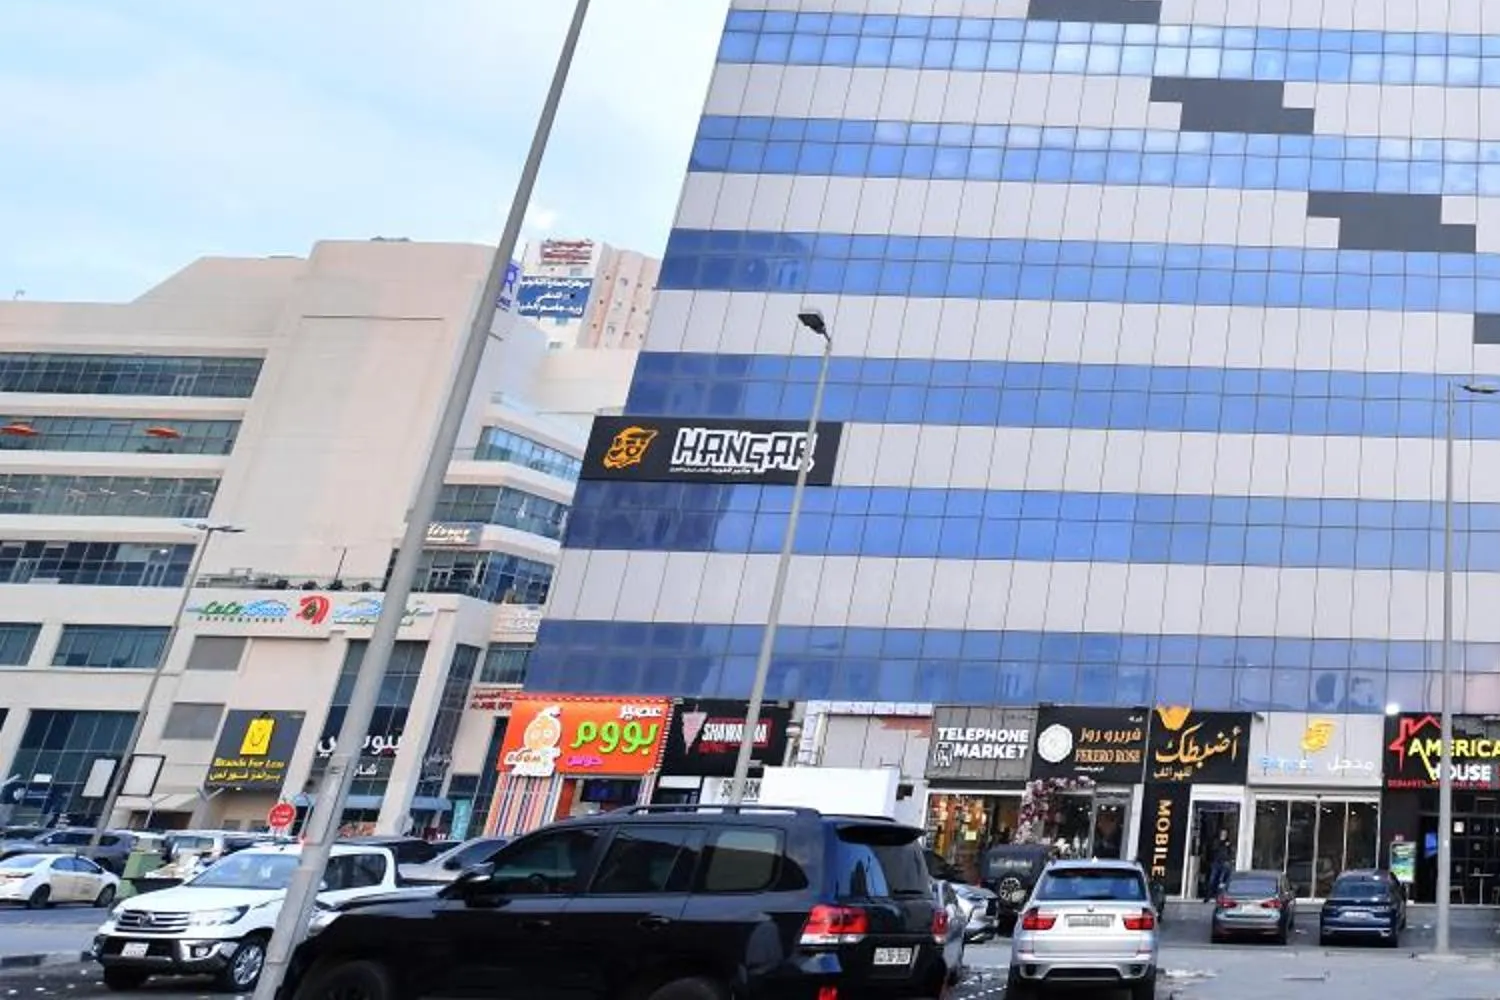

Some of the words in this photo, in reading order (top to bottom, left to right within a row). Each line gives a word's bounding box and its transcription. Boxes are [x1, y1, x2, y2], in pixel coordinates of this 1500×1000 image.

[671, 427, 817, 473] HANGAR
[937, 727, 1029, 742] TELEPHONE
[953, 743, 1028, 759] MARKET
[1151, 799, 1174, 878] MOBILE
